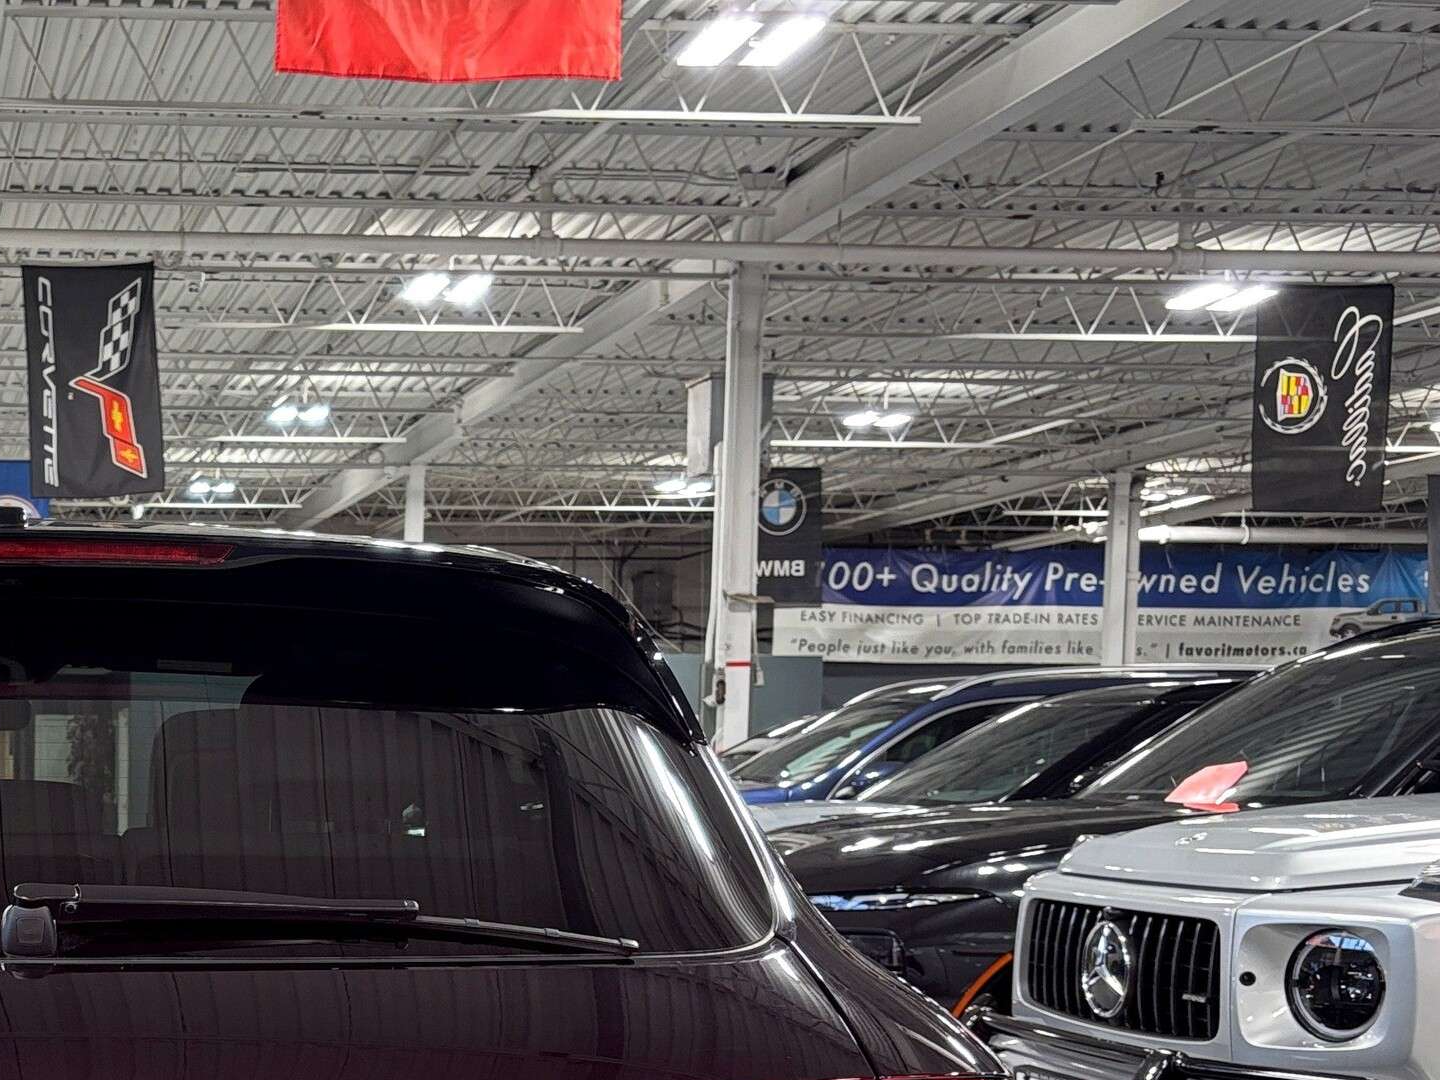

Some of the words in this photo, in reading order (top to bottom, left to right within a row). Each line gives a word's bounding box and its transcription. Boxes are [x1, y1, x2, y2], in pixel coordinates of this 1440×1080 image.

[38, 276, 59, 488] CORVETTE
[912, 561, 1032, 600] Quality
[1237, 561, 1371, 594] Vehicles
[801, 610, 835, 623] EASY
[841, 611, 924, 625] FINANCING
[954, 613, 981, 625] TOP
[988, 613, 1050, 625] TRADE-IN
[1057, 614, 1098, 626] RATES
[1137, 614, 1186, 627] ERVICE
[1193, 615, 1301, 627] MAINTENANCE
[857, 640, 885, 655] just
[891, 640, 919, 654] like
[964, 640, 995, 655] with
[1002, 640, 1061, 655] families
[1066, 640, 1093, 655] like
